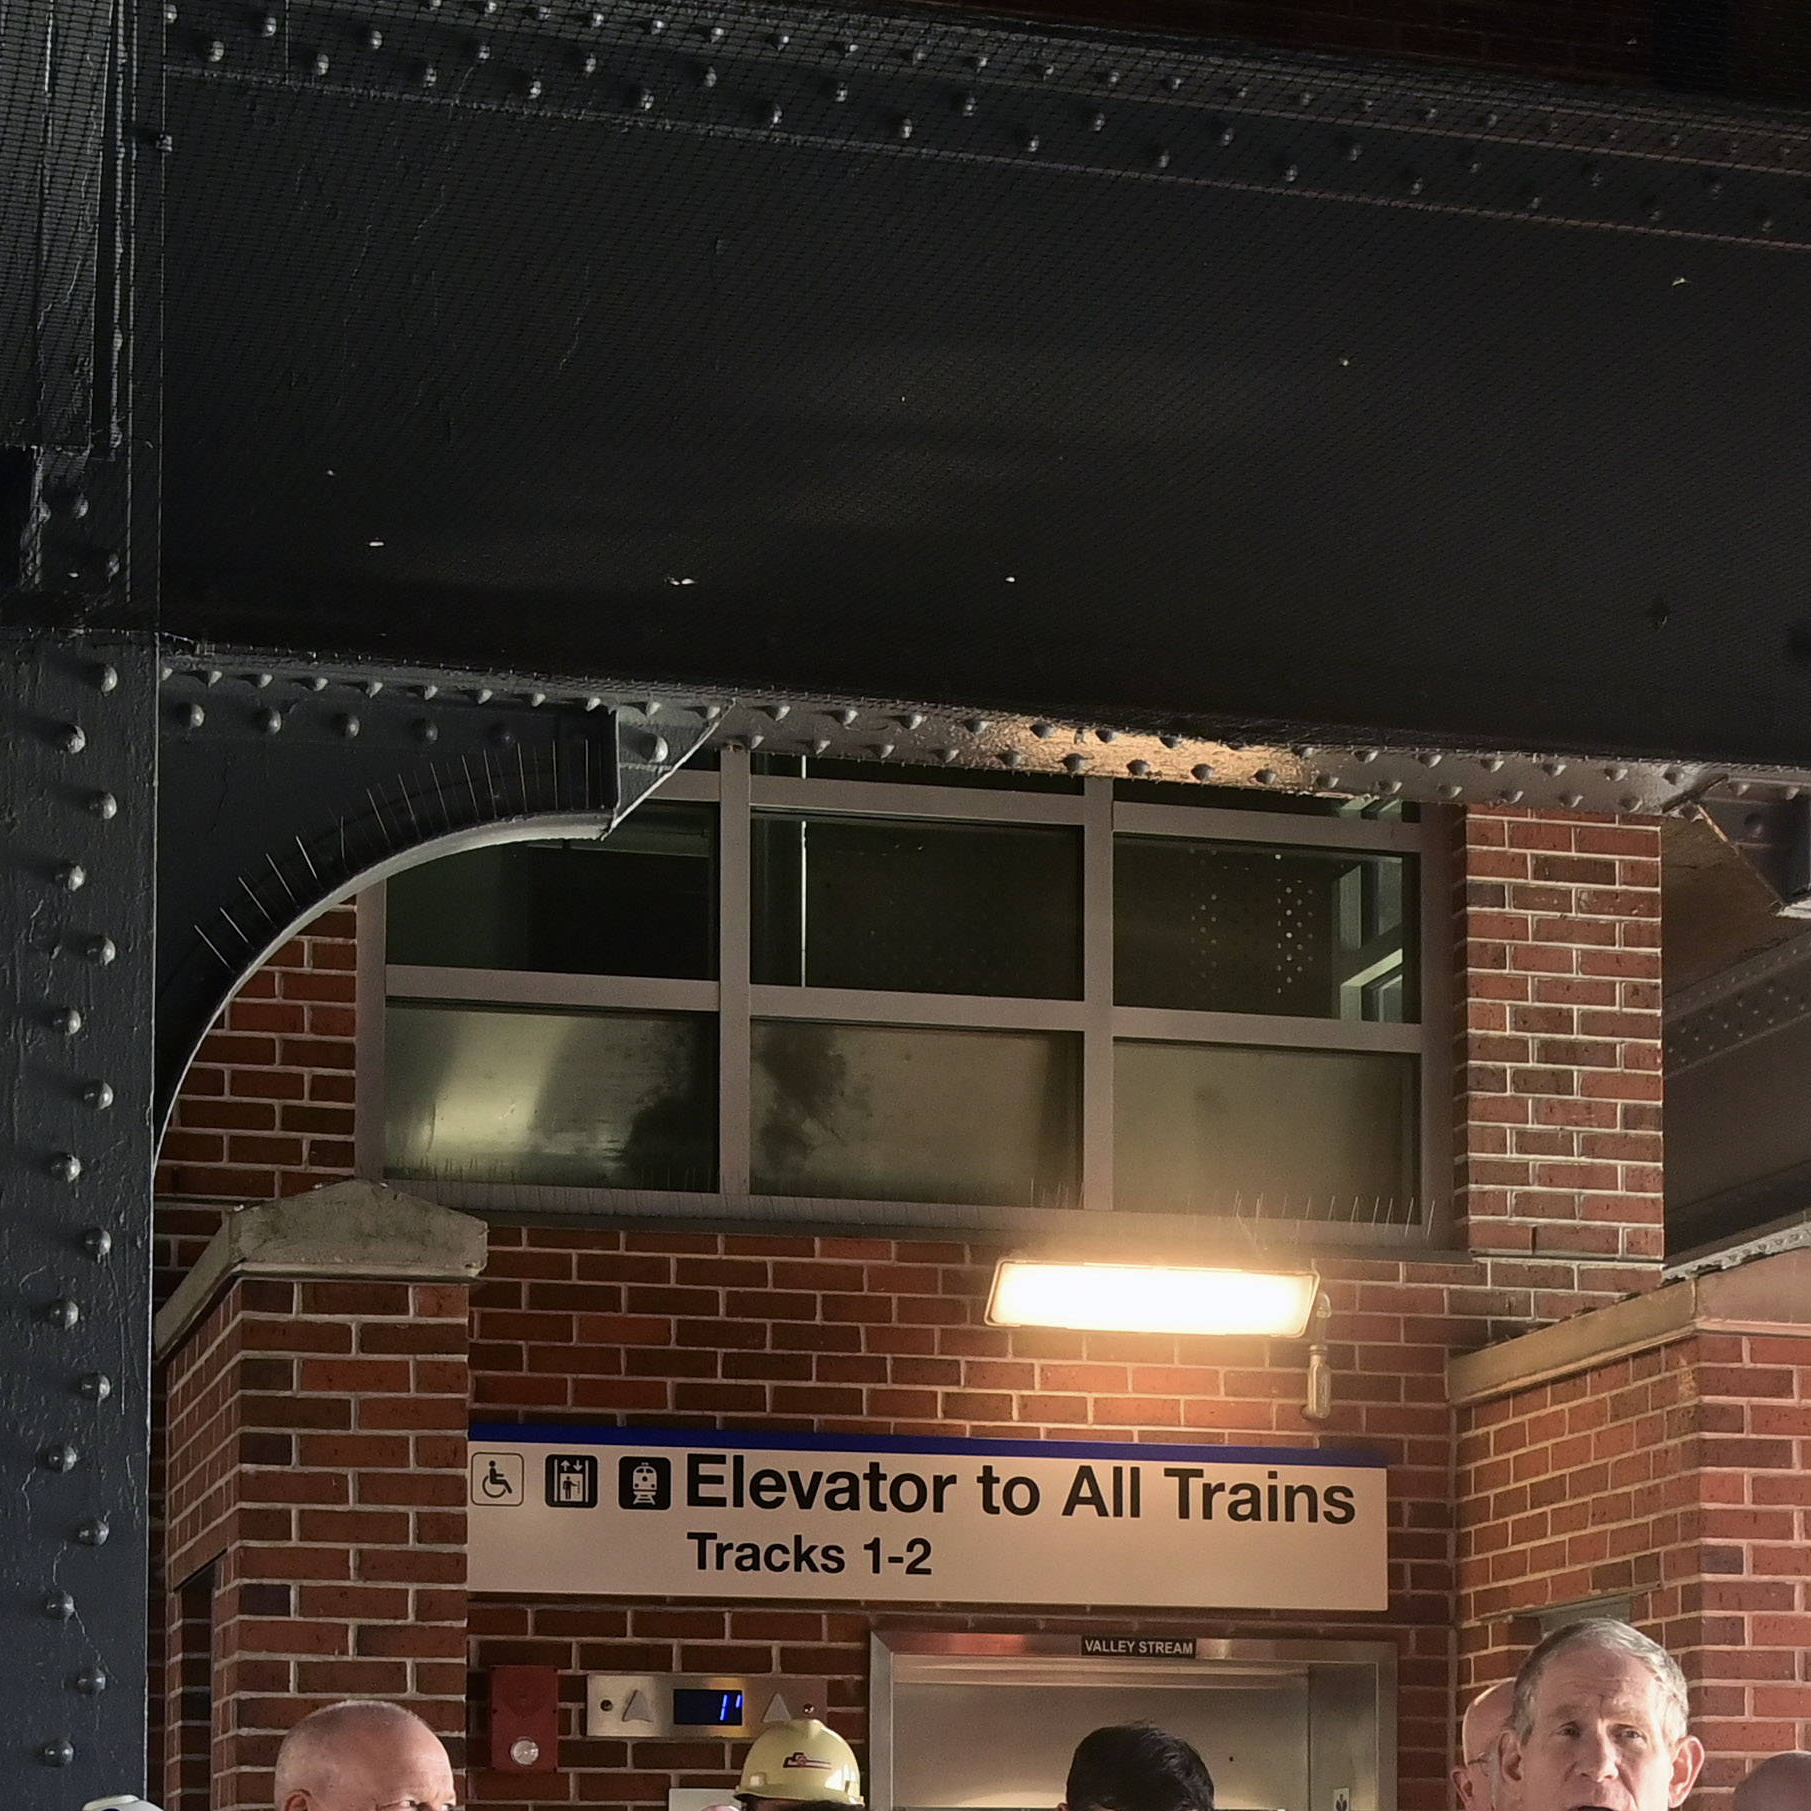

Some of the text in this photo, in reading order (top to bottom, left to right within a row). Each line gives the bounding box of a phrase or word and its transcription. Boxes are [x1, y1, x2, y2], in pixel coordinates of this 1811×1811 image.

[686, 1453, 1357, 1525] Elevator to All Trains
[686, 1531, 933, 1576] Tracks 1-2
[1084, 1639, 1194, 1655] VALLEY STREAM
